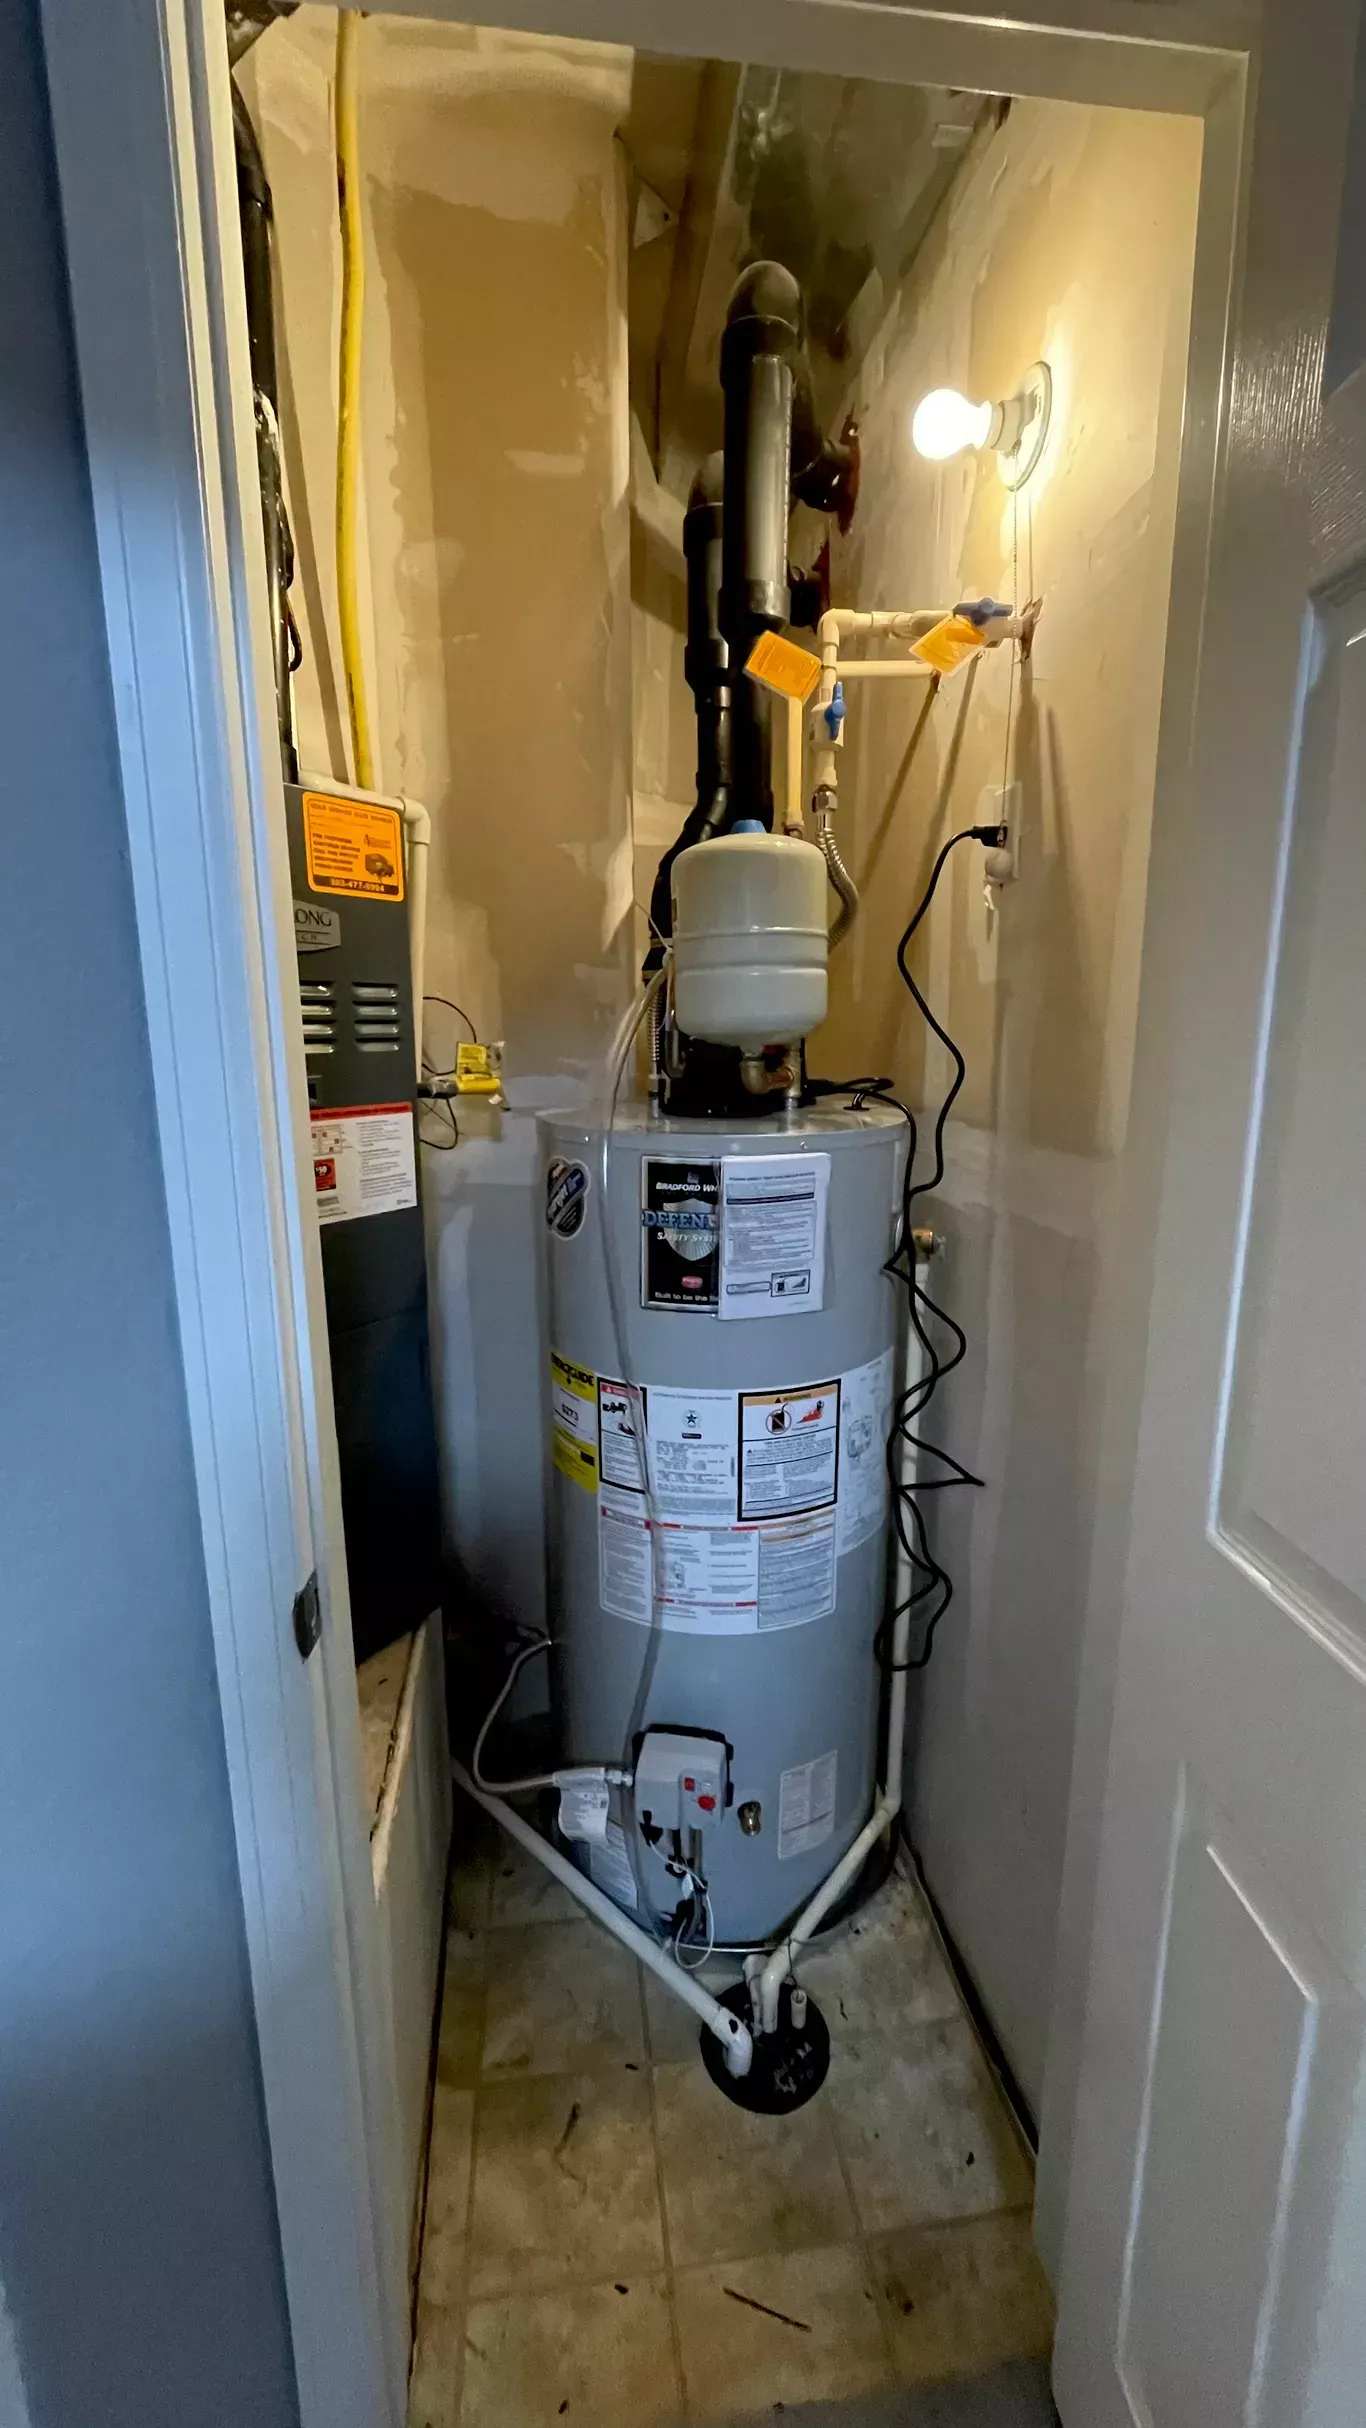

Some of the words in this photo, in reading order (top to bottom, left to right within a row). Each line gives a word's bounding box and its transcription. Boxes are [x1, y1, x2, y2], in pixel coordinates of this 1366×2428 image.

[294, 908, 332, 927] ONG
[656, 1182, 701, 1192] BRADFORD
[643, 1211, 713, 1230] DEFEN
